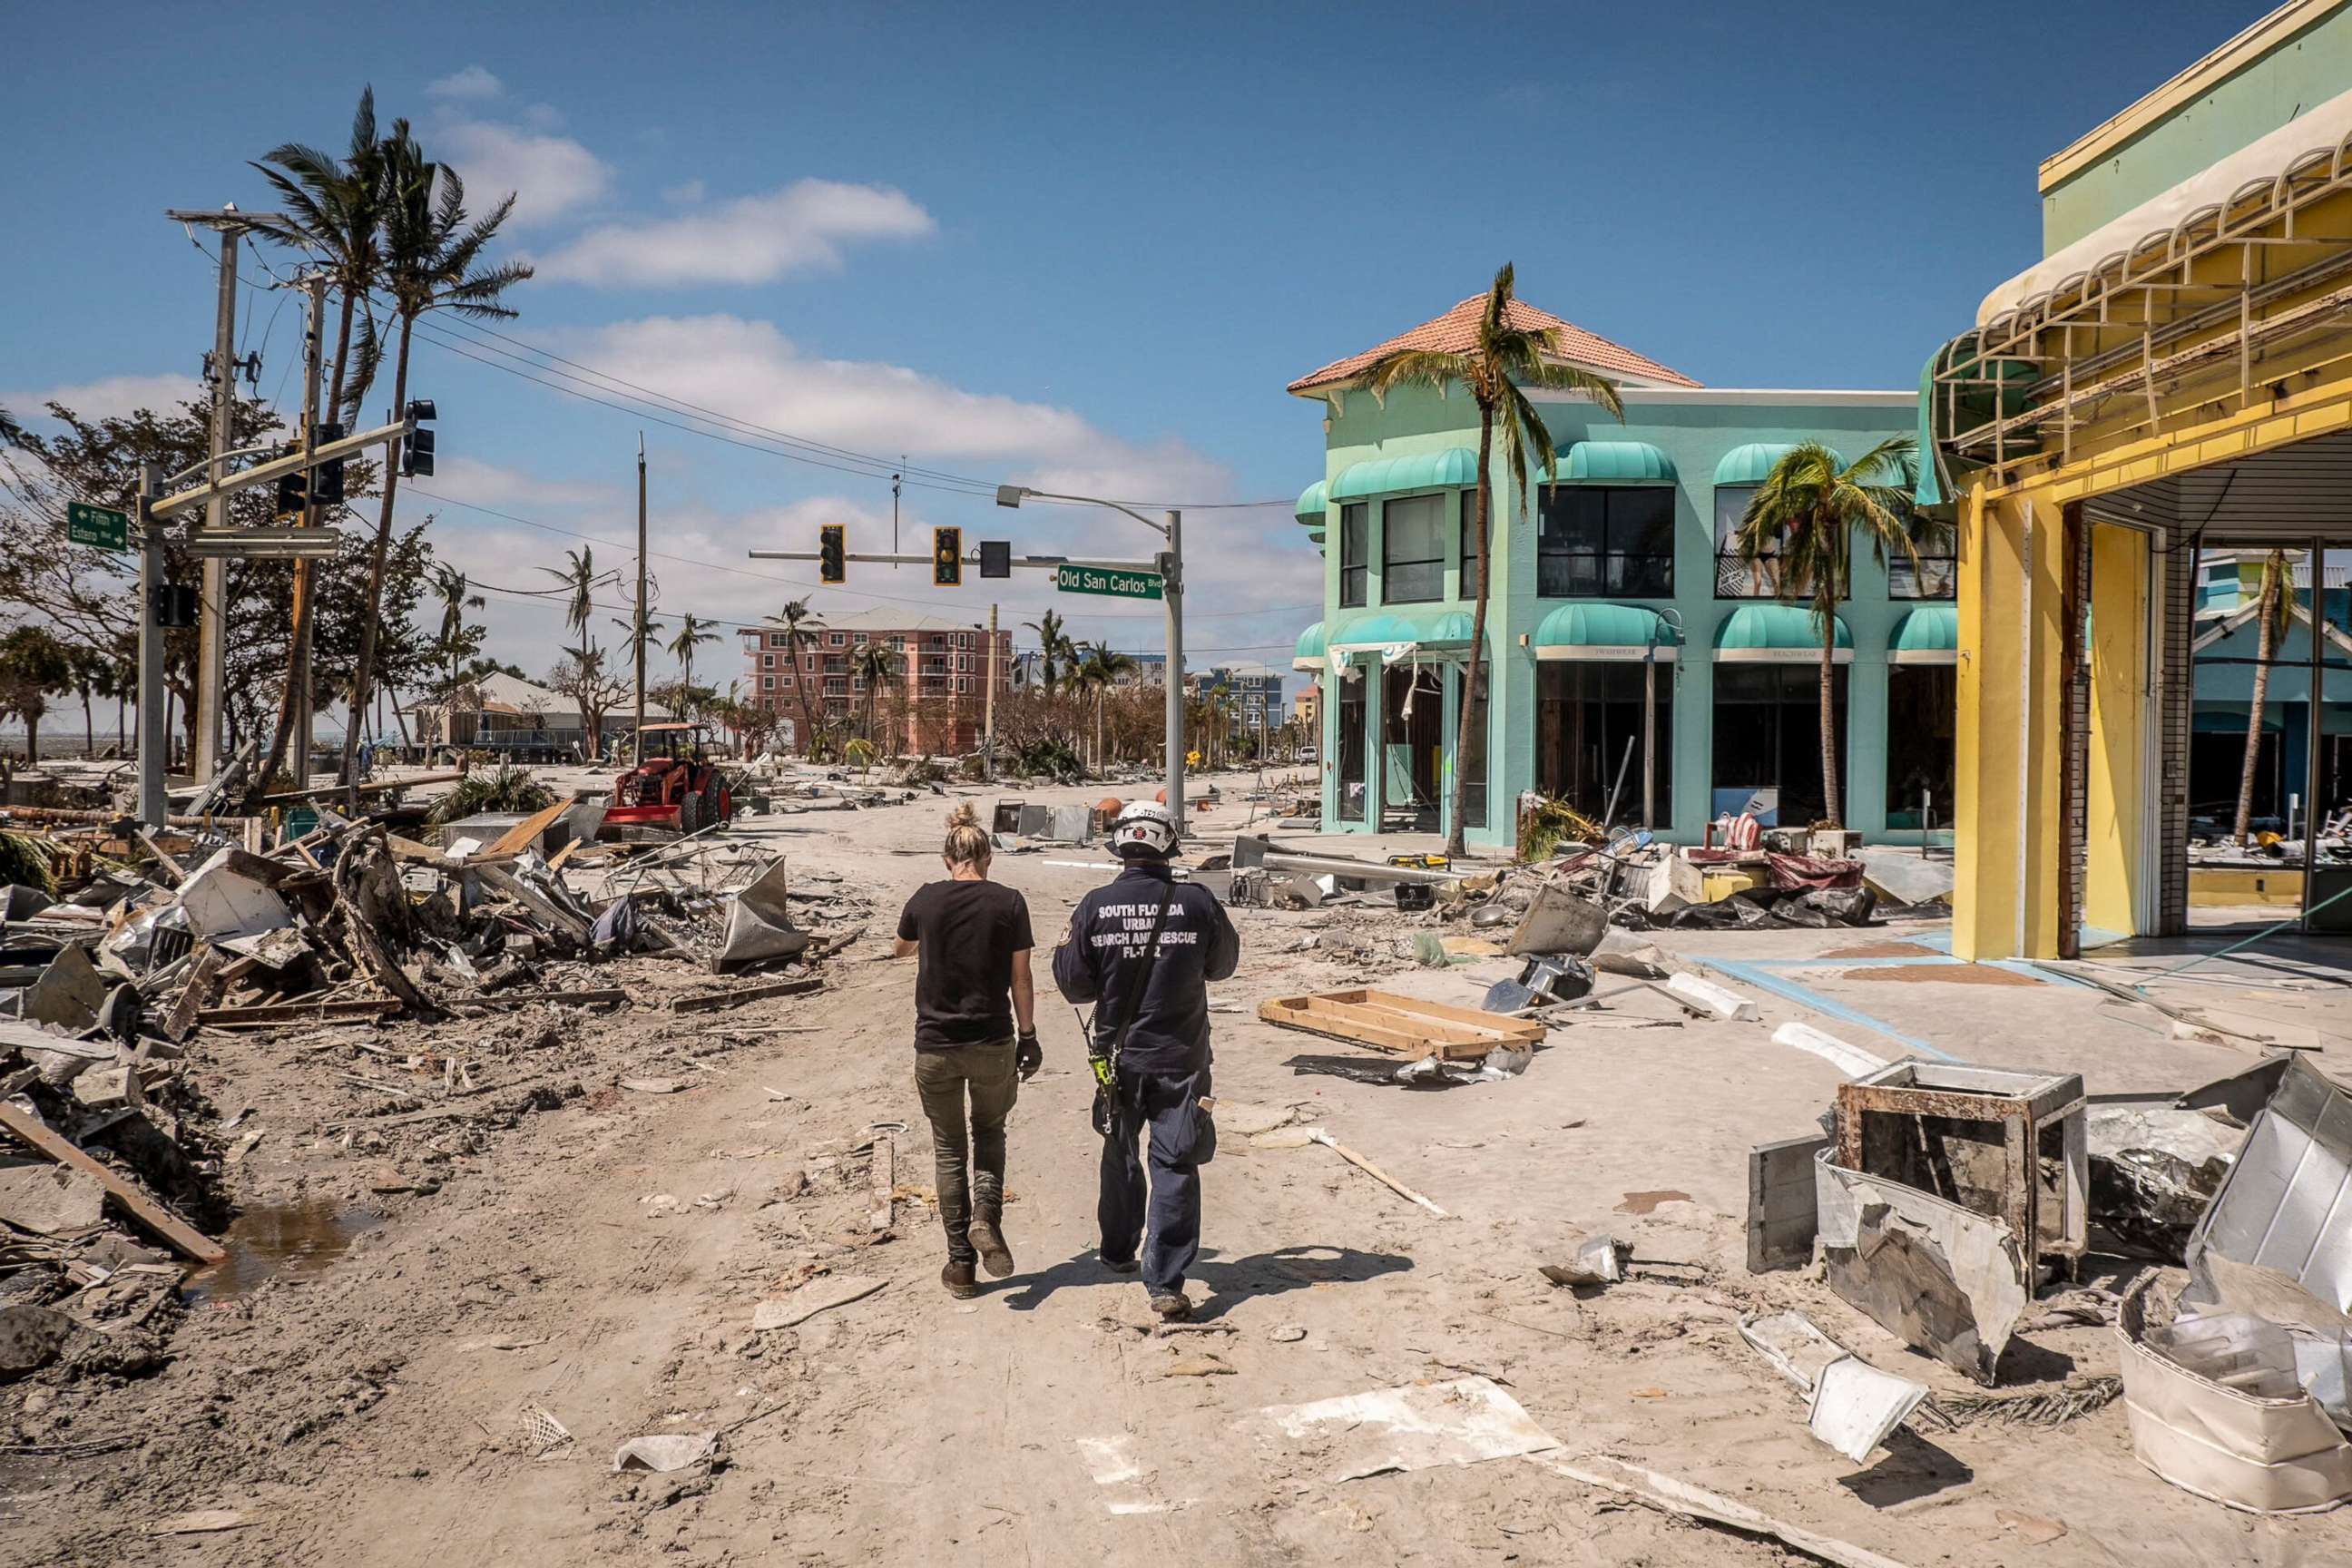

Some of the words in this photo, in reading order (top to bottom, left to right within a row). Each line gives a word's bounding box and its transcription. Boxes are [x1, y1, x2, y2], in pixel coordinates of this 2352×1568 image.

[1060, 570, 1080, 588] Old
[1083, 573, 1106, 590] San
[1110, 575, 1146, 593] Carlos
[1148, 578, 1161, 588] Blvd
[1099, 904, 1136, 919] SOUTH
[1138, 903, 1185, 917] FLODA
[1122, 917, 1157, 931] URBA
[1091, 932, 1130, 947] SEARCH
[1122, 946, 1161, 959] FL-T2
